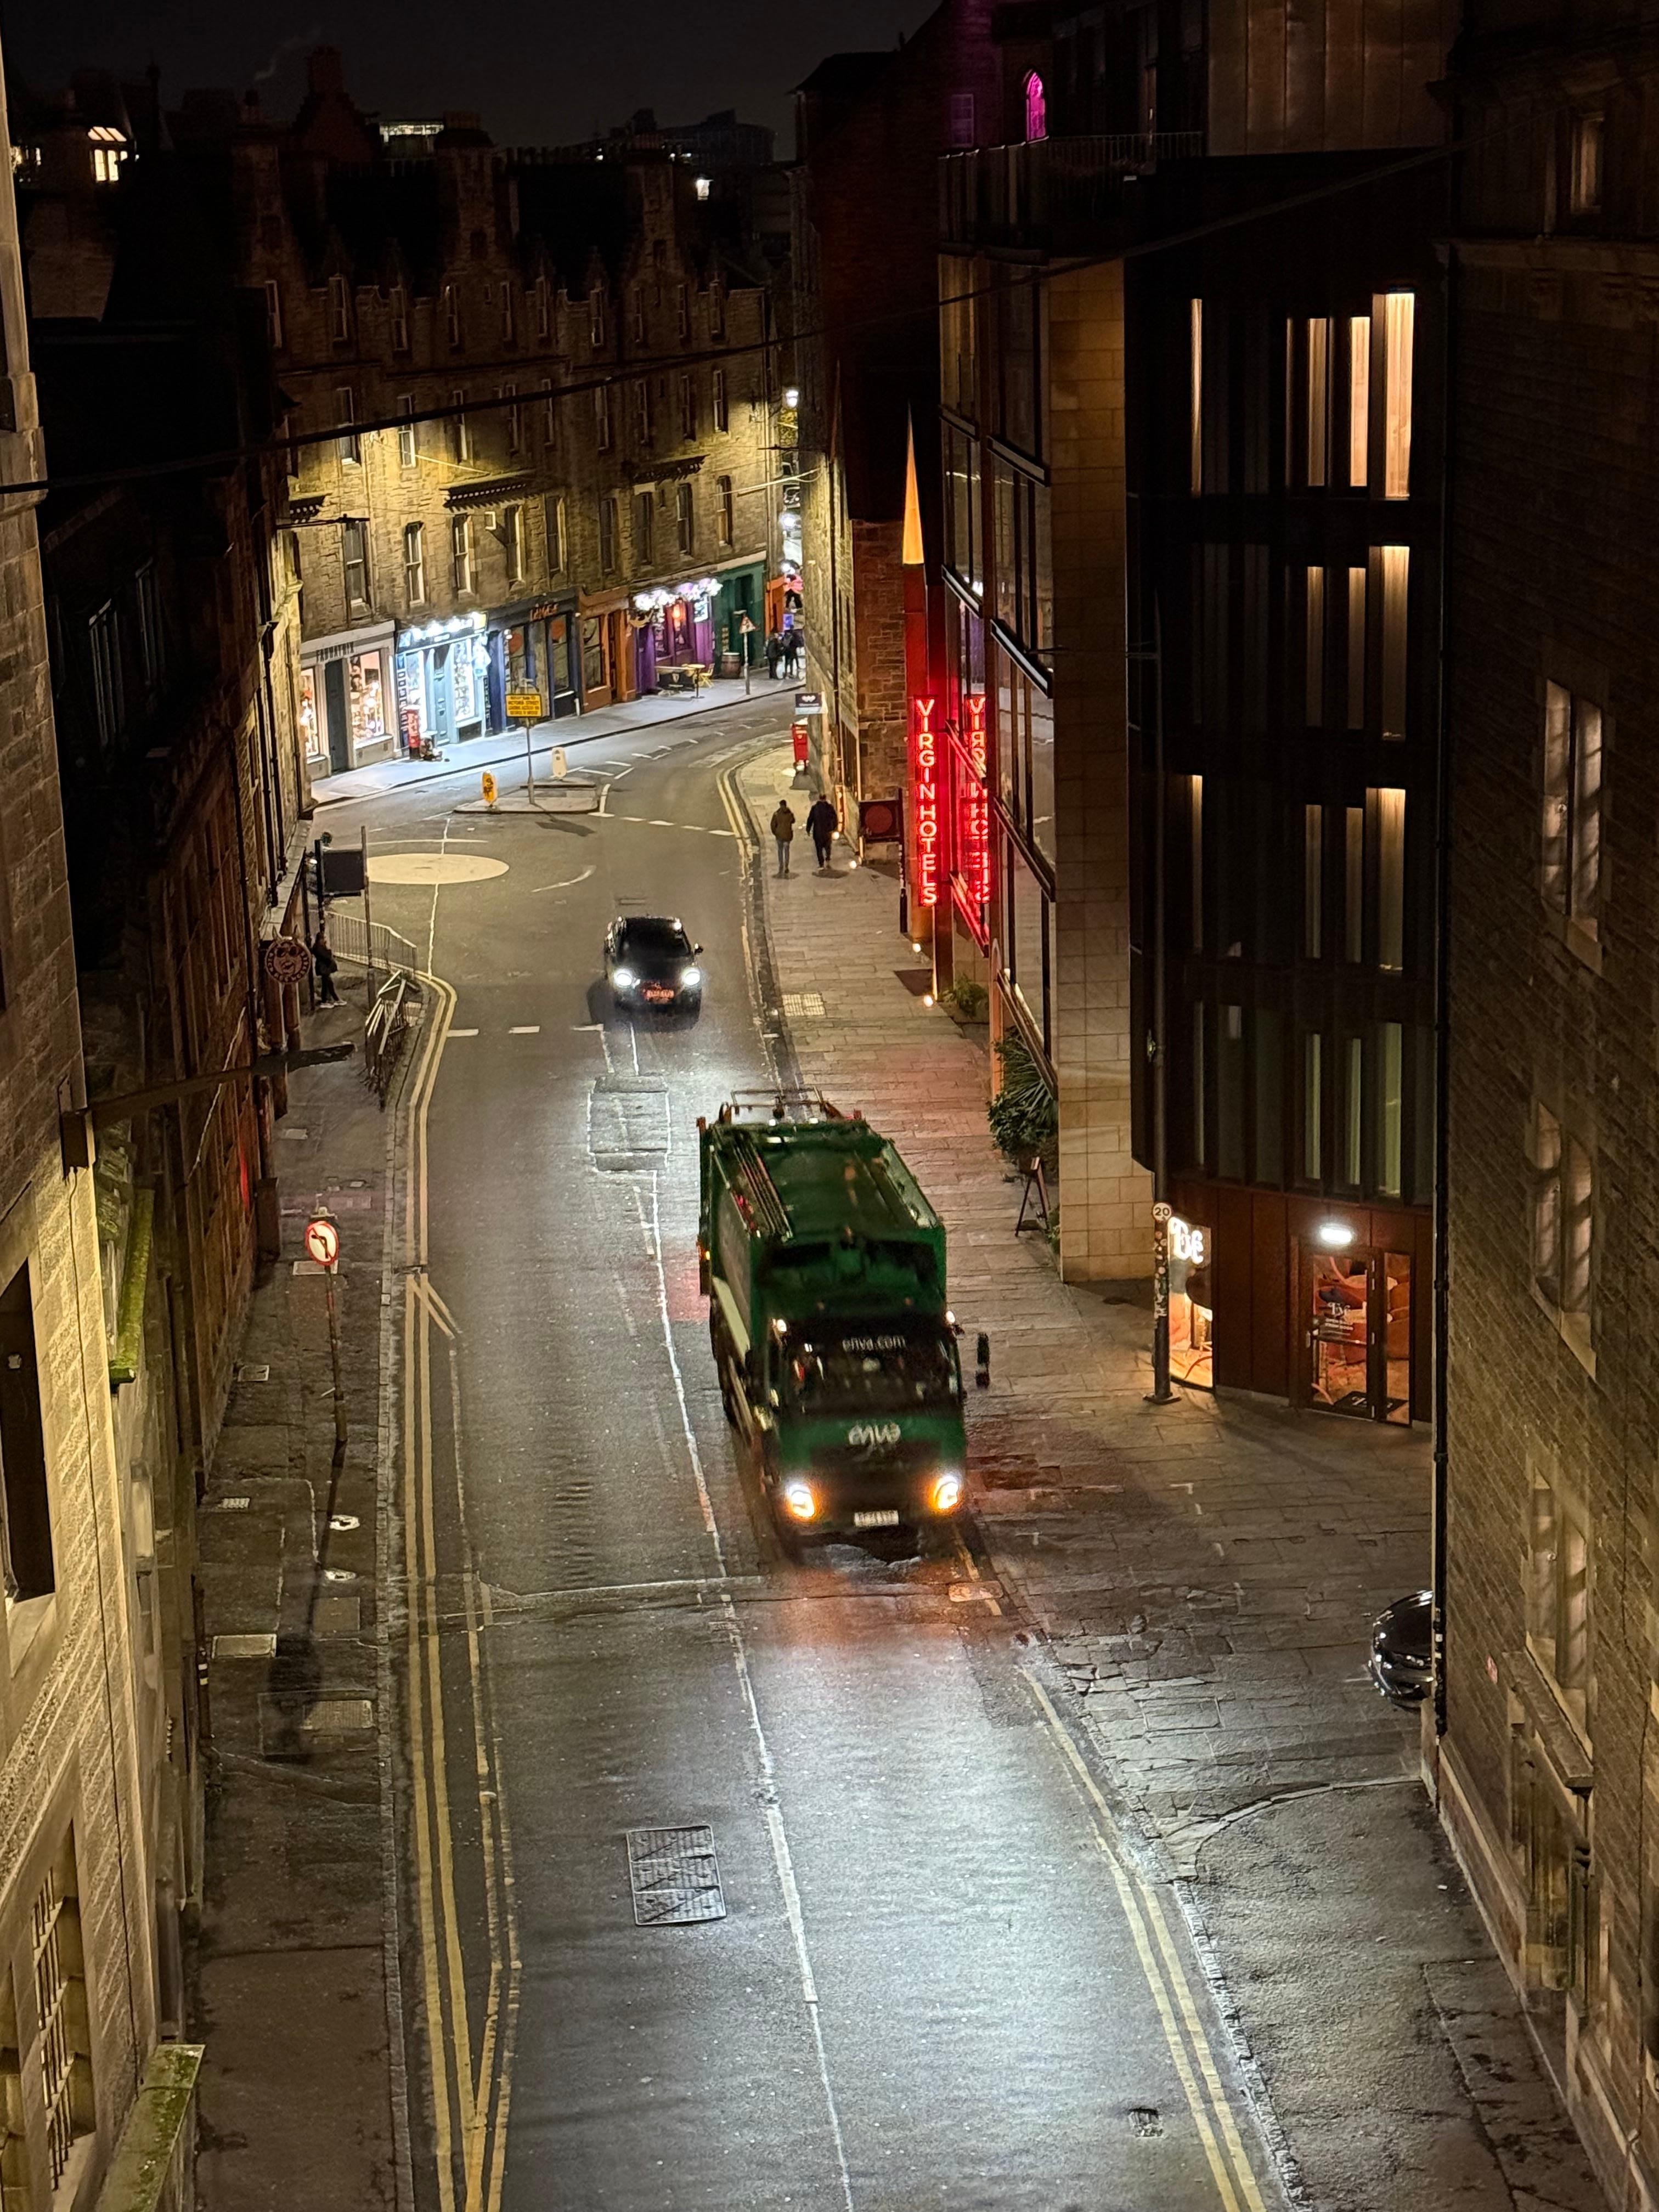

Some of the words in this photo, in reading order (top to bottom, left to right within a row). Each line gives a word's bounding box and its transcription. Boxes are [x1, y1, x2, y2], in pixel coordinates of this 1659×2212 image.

[916, 698, 936, 800] VIRGIN
[919, 803, 938, 905] HOTELS
[1154, 1207, 1170, 1216] 20
